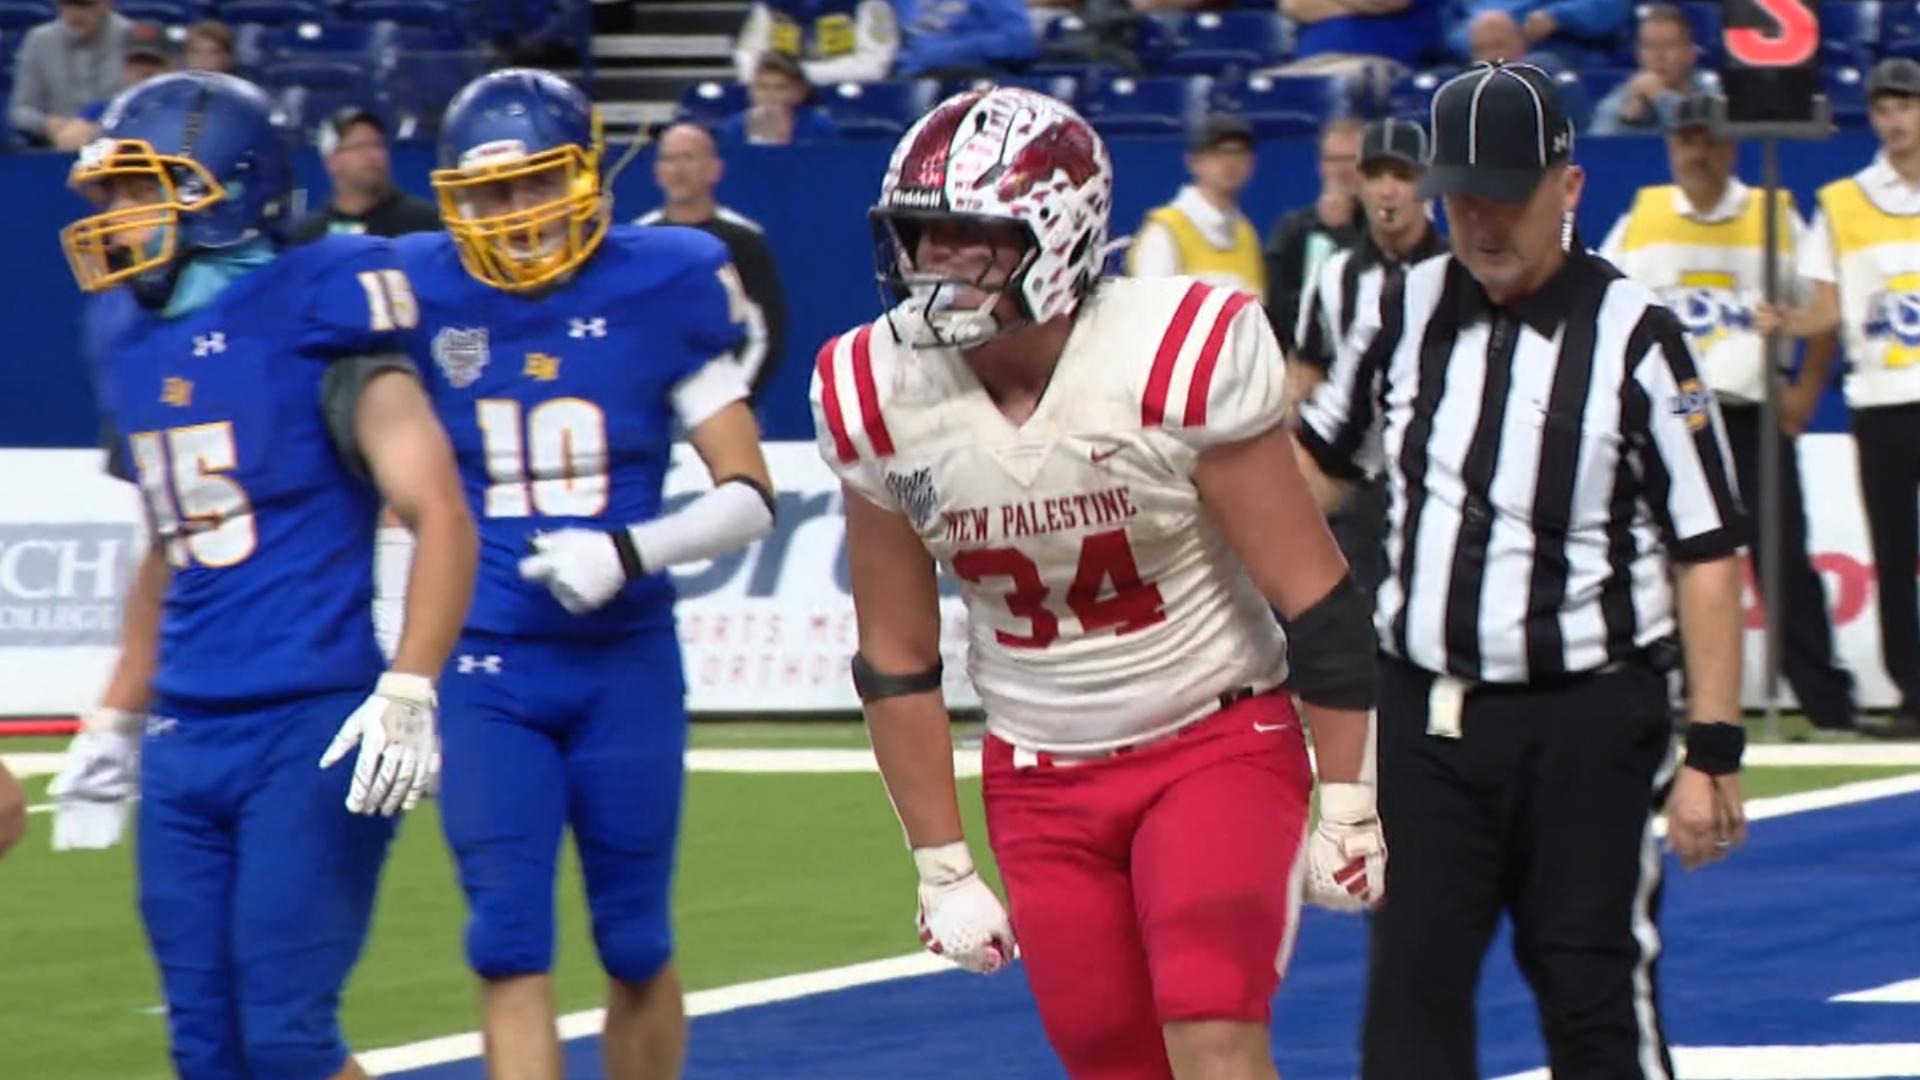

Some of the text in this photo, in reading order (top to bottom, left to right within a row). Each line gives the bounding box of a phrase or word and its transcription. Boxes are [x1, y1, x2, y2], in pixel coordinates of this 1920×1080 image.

[892, 189, 941, 208] Riddell
[129, 420, 258, 568] 15
[475, 396, 609, 518] 10
[941, 485, 1138, 541] NEW PALESTINE
[0, 538, 123, 600] CH
[953, 527, 1167, 649] 34
